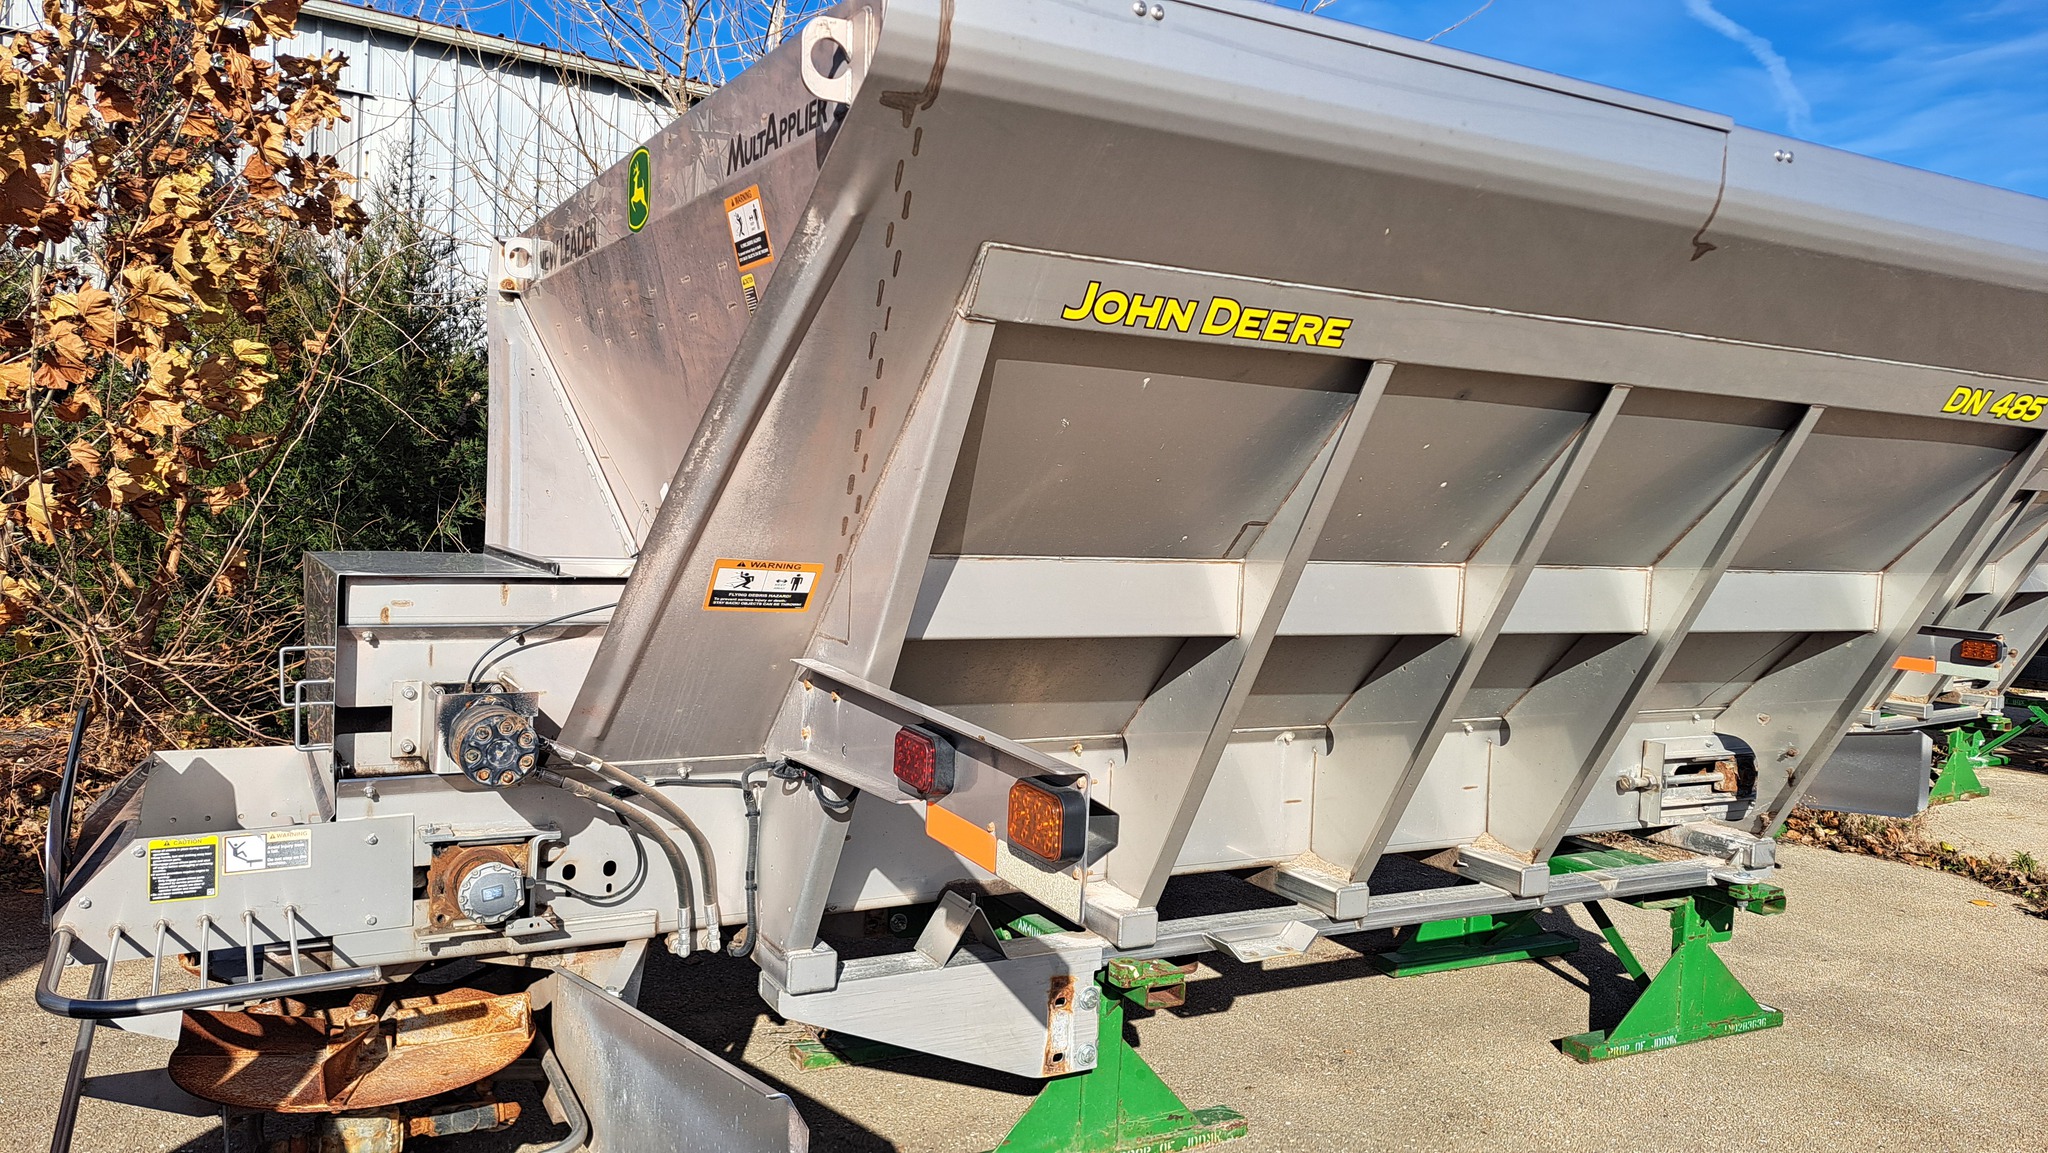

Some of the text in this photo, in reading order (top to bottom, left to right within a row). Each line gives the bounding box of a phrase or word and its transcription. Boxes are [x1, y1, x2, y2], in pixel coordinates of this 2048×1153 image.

[734, 190, 752, 204] WARNING
[560, 217, 597, 266] LEADER
[1061, 280, 1354, 348] JOHN DEERE
[1941, 385, 2048, 423] DN 485
[750, 562, 802, 570] WARNING
[276, 830, 308, 838] WARNING
[1635, 1040, 1646, 1052] OF
